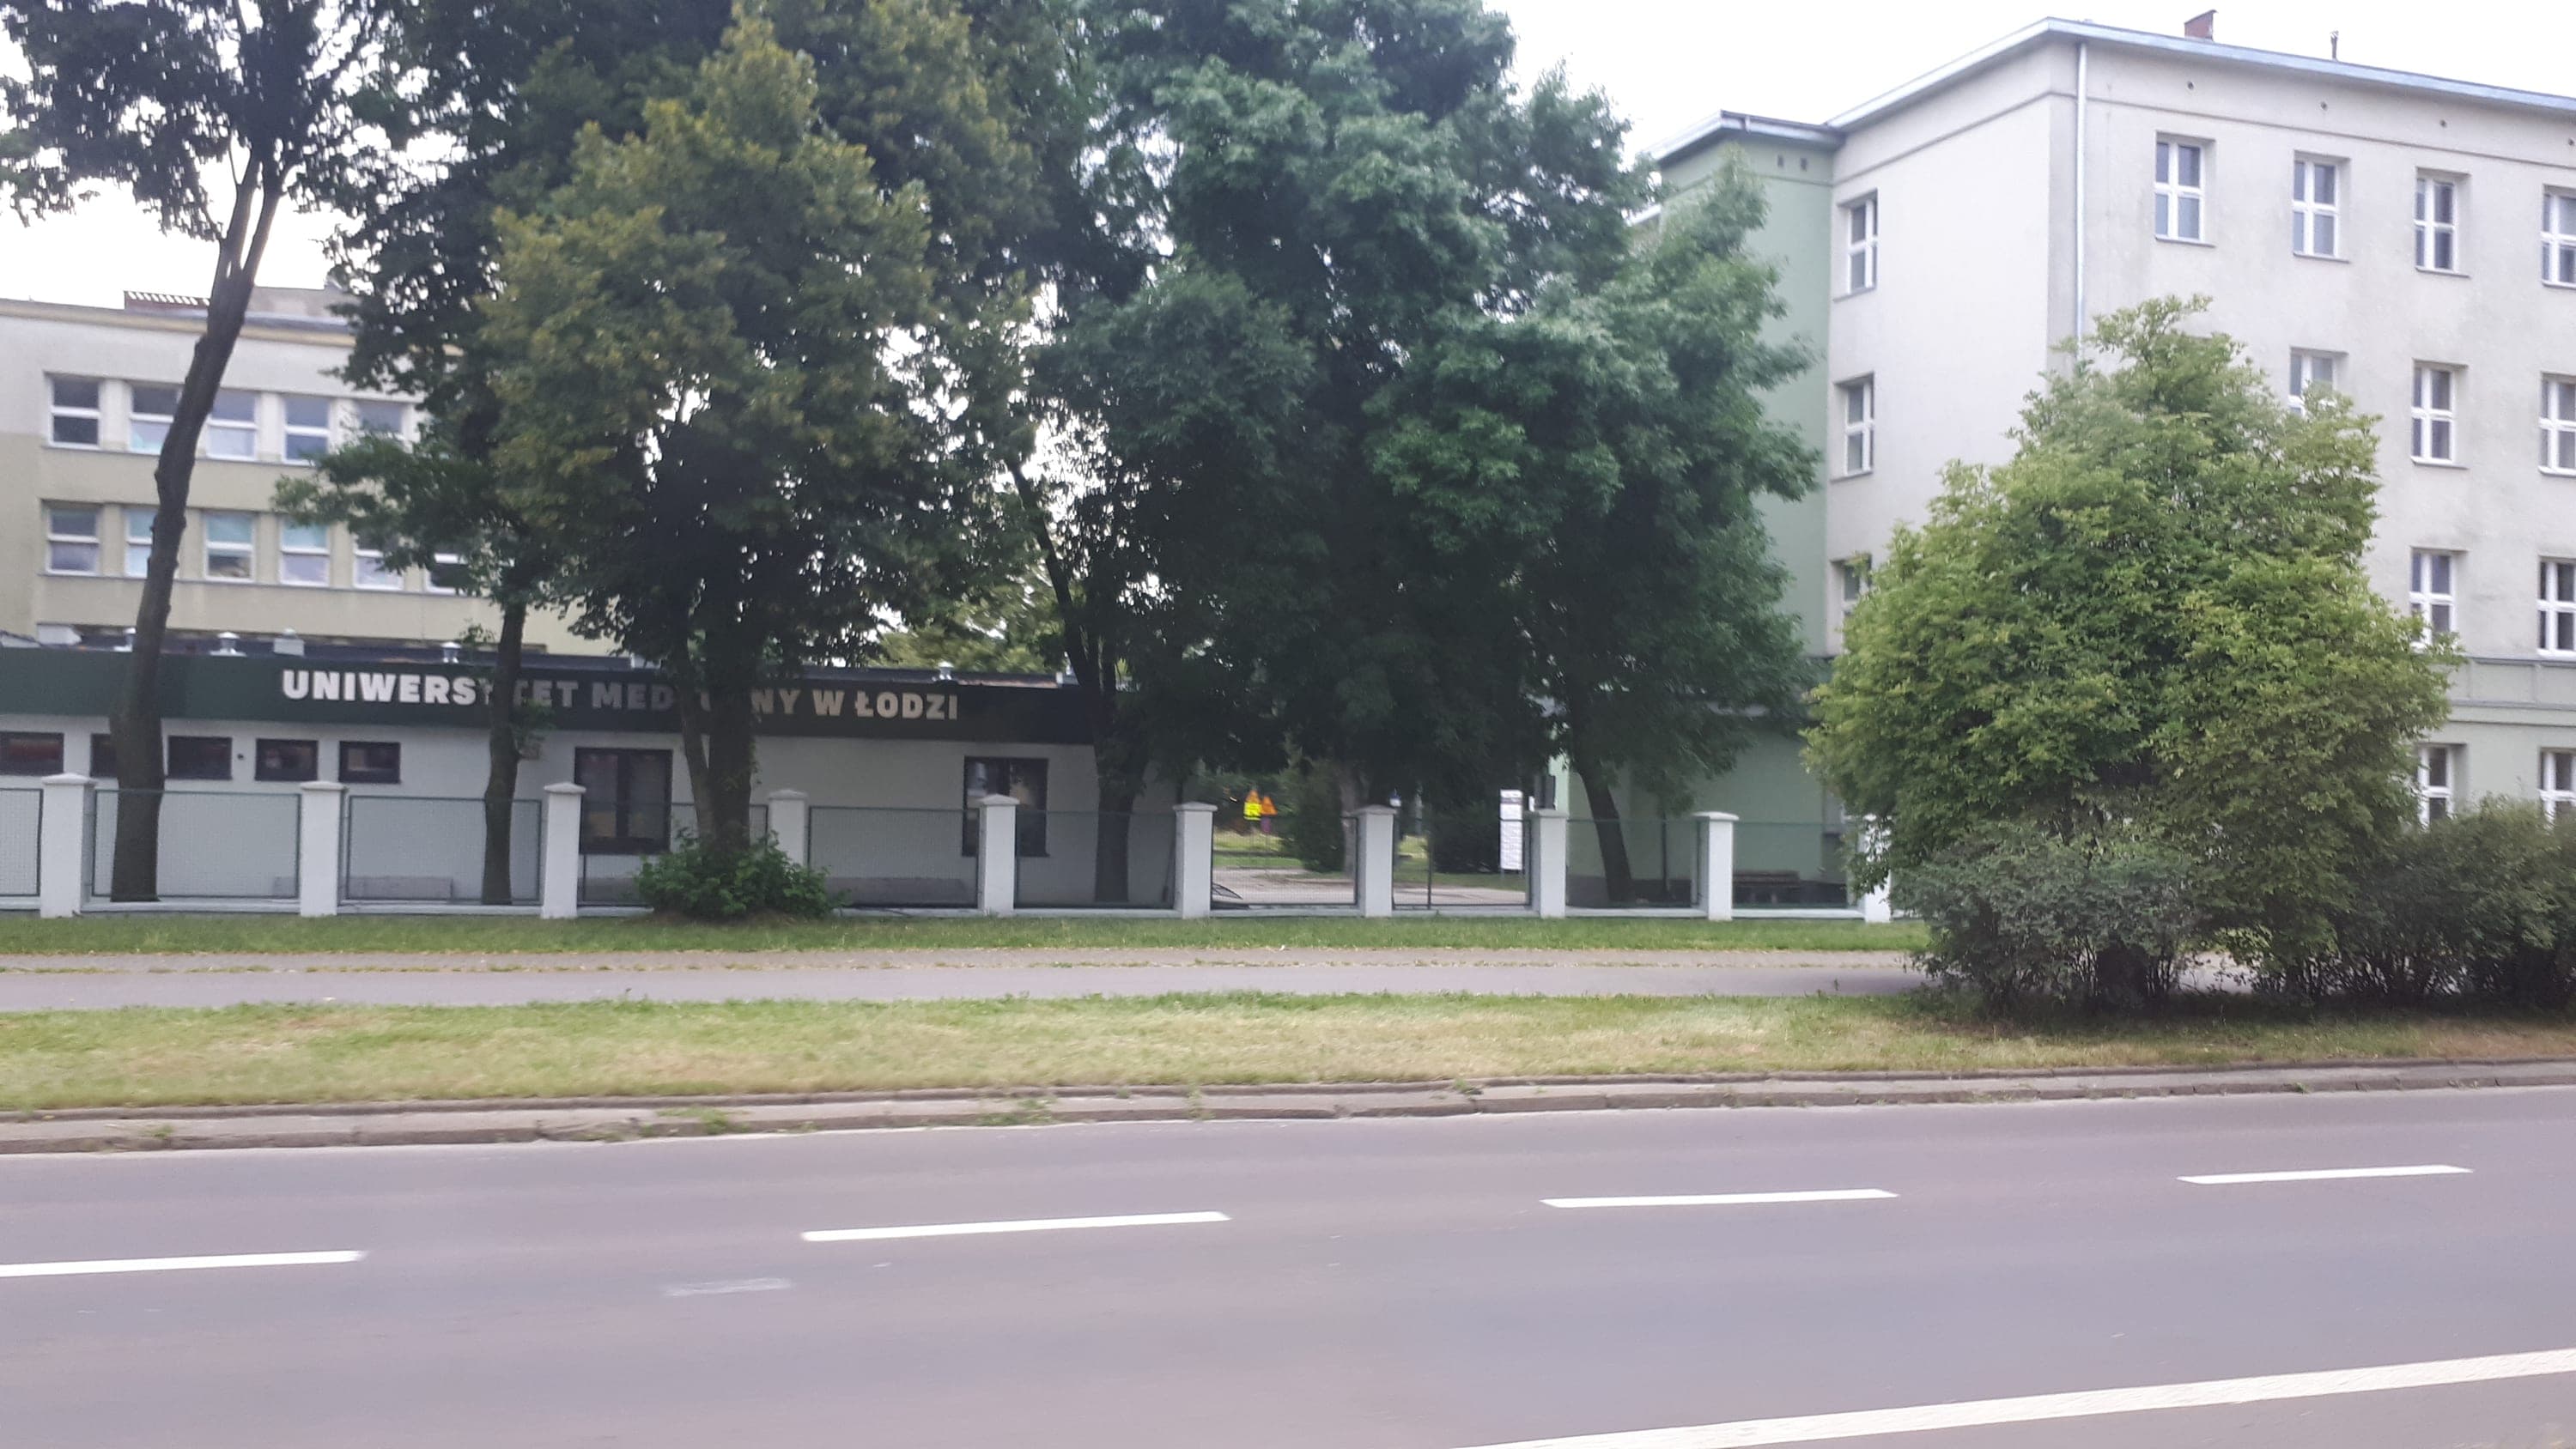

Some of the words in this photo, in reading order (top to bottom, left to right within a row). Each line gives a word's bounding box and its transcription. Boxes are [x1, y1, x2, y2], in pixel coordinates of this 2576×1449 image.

[592, 682, 800, 714] MEDNY
[813, 689, 845, 717] W
[854, 691, 958, 720] ŁODZI
